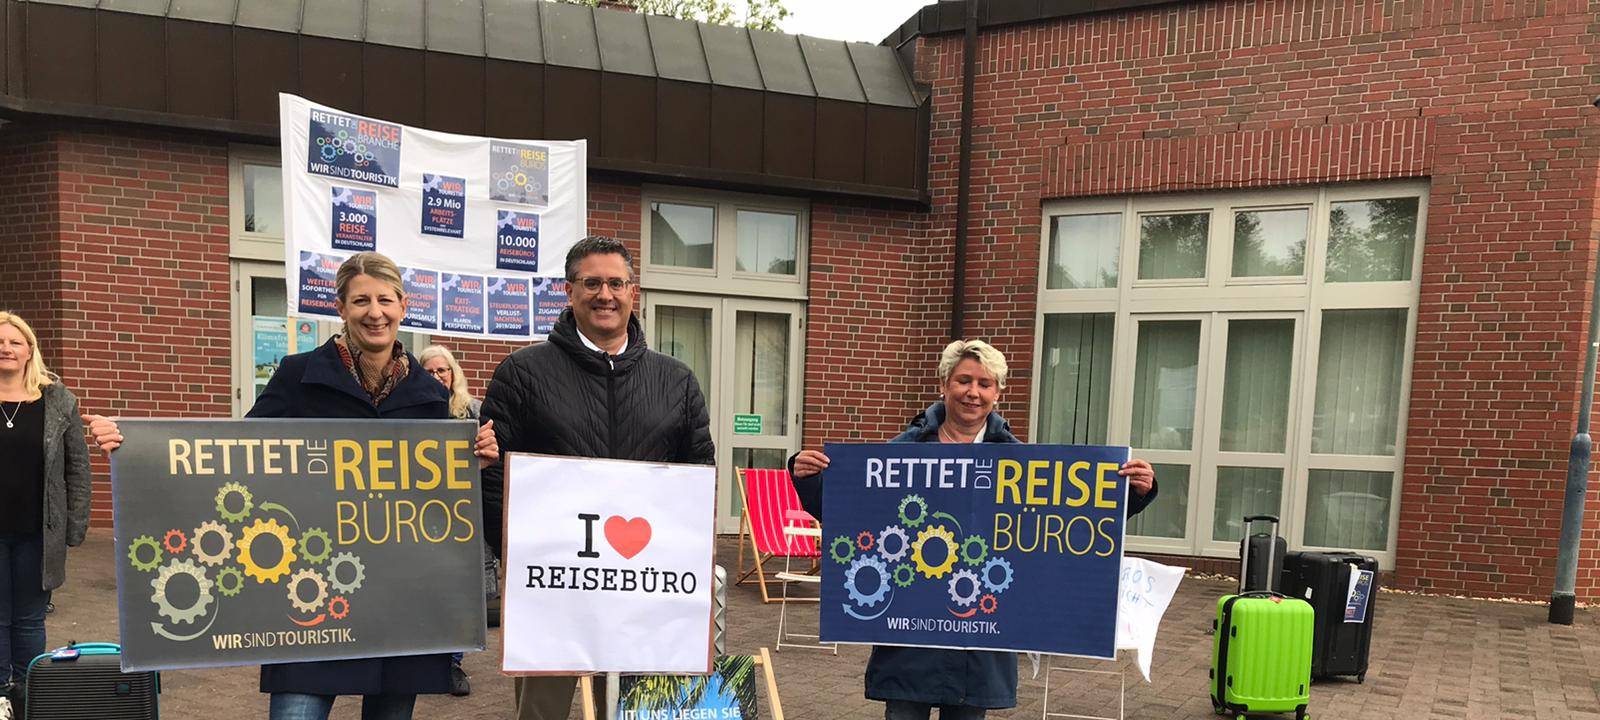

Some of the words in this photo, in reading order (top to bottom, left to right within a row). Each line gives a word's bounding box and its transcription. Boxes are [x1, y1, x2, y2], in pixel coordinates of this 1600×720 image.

[312, 111, 351, 128] RETTET
[357, 120, 399, 141] REISE
[357, 135, 399, 151] BRANCHE
[521, 149, 546, 161] REISE
[444, 182, 462, 192] WIR
[353, 194, 372, 205] WIR
[427, 196, 442, 207] 2.9
[443, 198, 461, 210] Mio
[349, 203, 375, 211] TOURISTIK
[339, 212, 368, 223] 3.000
[517, 217, 535, 227] WIR
[339, 223, 369, 235] REISE-
[513, 224, 537, 232] TOURISTIK
[335, 233, 373, 241] VERANSTALTER
[499, 235, 536, 249] 10.000
[341, 239, 374, 248] DEUTSCHLAND
[499, 248, 535, 258] REISEBÜROS
[505, 258, 536, 267] DEUTSCHLAND
[411, 281, 436, 289] TOURISTIK
[416, 275, 434, 284] WIR
[461, 280, 480, 290] WIR
[507, 283, 526, 293] WIR
[446, 304, 480, 315] STRATEGIE
[496, 309, 522, 317] VERLUST-
[444, 321, 481, 332] PERSPEKTIVEN
[495, 322, 522, 331] 2019/2020
[169, 438, 304, 475] RETTET
[307, 438, 328, 475] DIE
[333, 439, 472, 491] REISE
[866, 457, 974, 489] RETTET
[974, 458, 992, 490] DIE
[995, 459, 1120, 509] REISE
[336, 493, 474, 545] BÜROS
[577, 513, 600, 559] I
[993, 507, 1115, 557] BÜROS
[526, 565, 697, 595] REISEBÜRO
[641, 709, 668, 720] UNS
[672, 708, 717, 720] LIEGEN
[721, 706, 741, 719] SIE
